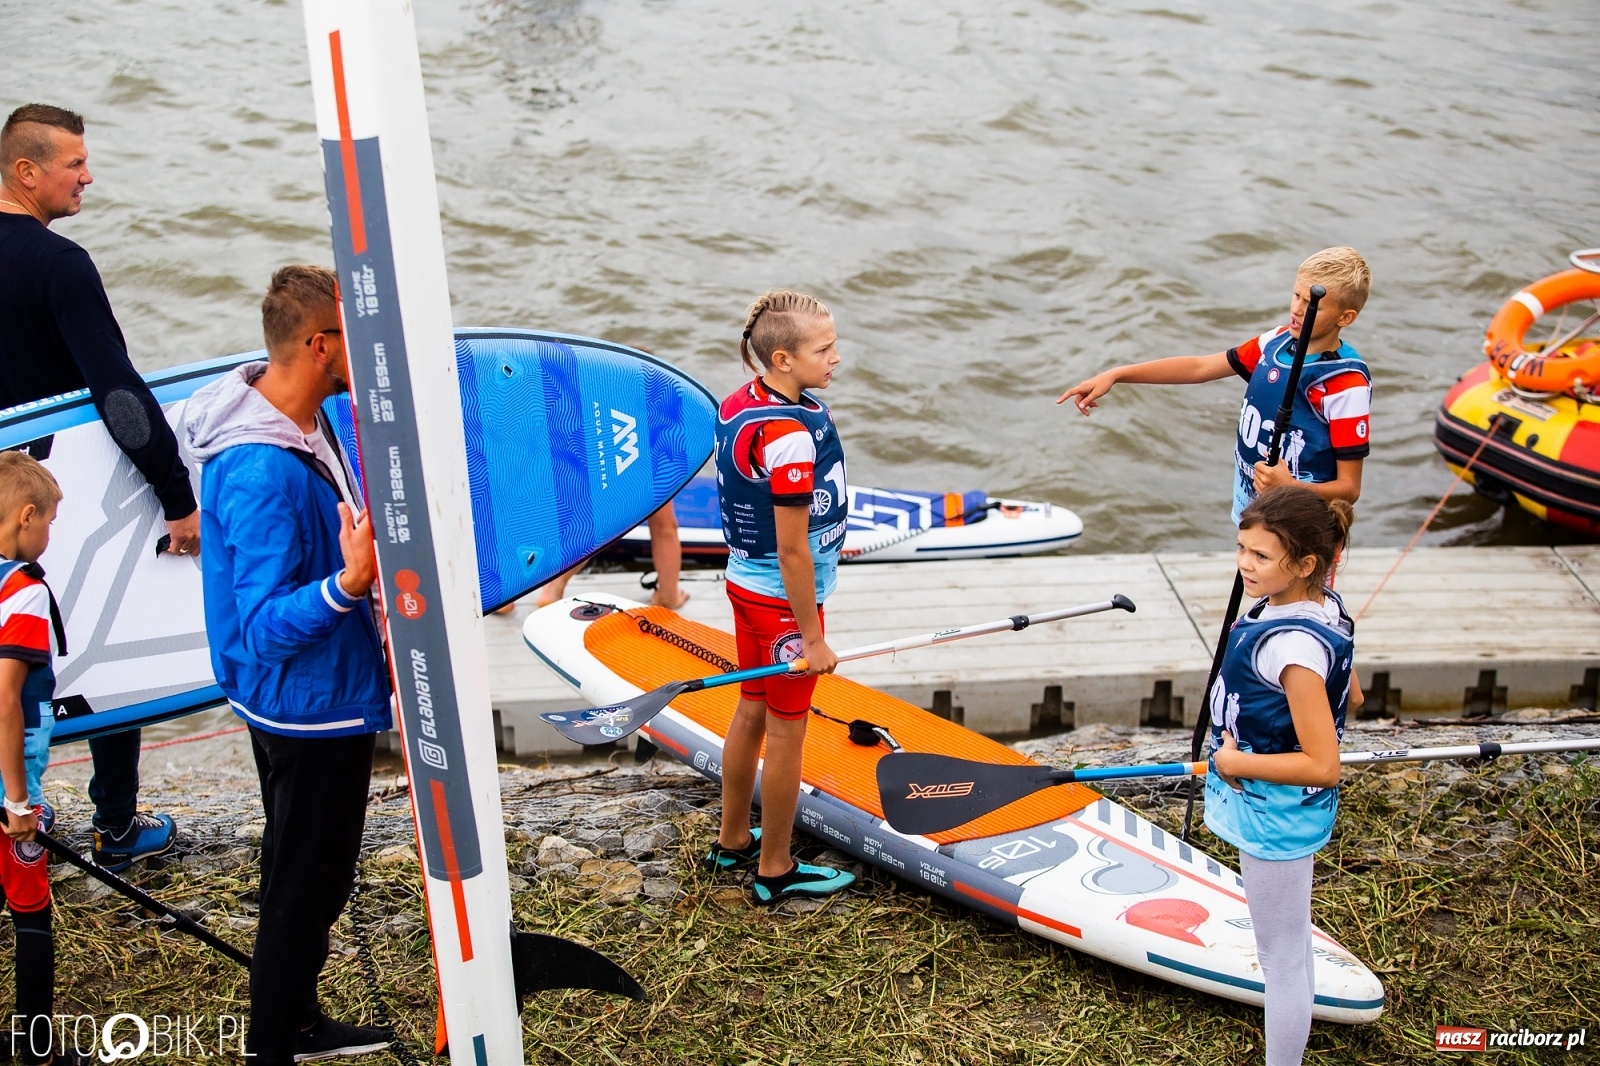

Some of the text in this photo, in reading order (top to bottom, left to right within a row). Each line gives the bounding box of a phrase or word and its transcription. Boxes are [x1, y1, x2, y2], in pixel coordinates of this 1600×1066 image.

[352, 270, 365, 318] VOLUME
[362, 264, 379, 316] 180ltr
[593, 401, 608, 490] AQUA MARINA
[384, 502, 398, 544] LENGTH
[410, 648, 438, 739] GLADIATOR
[801, 806, 824, 821] LENGTH
[919, 860, 946, 877] VOLUME
[919, 869, 948, 888] 180ltr
